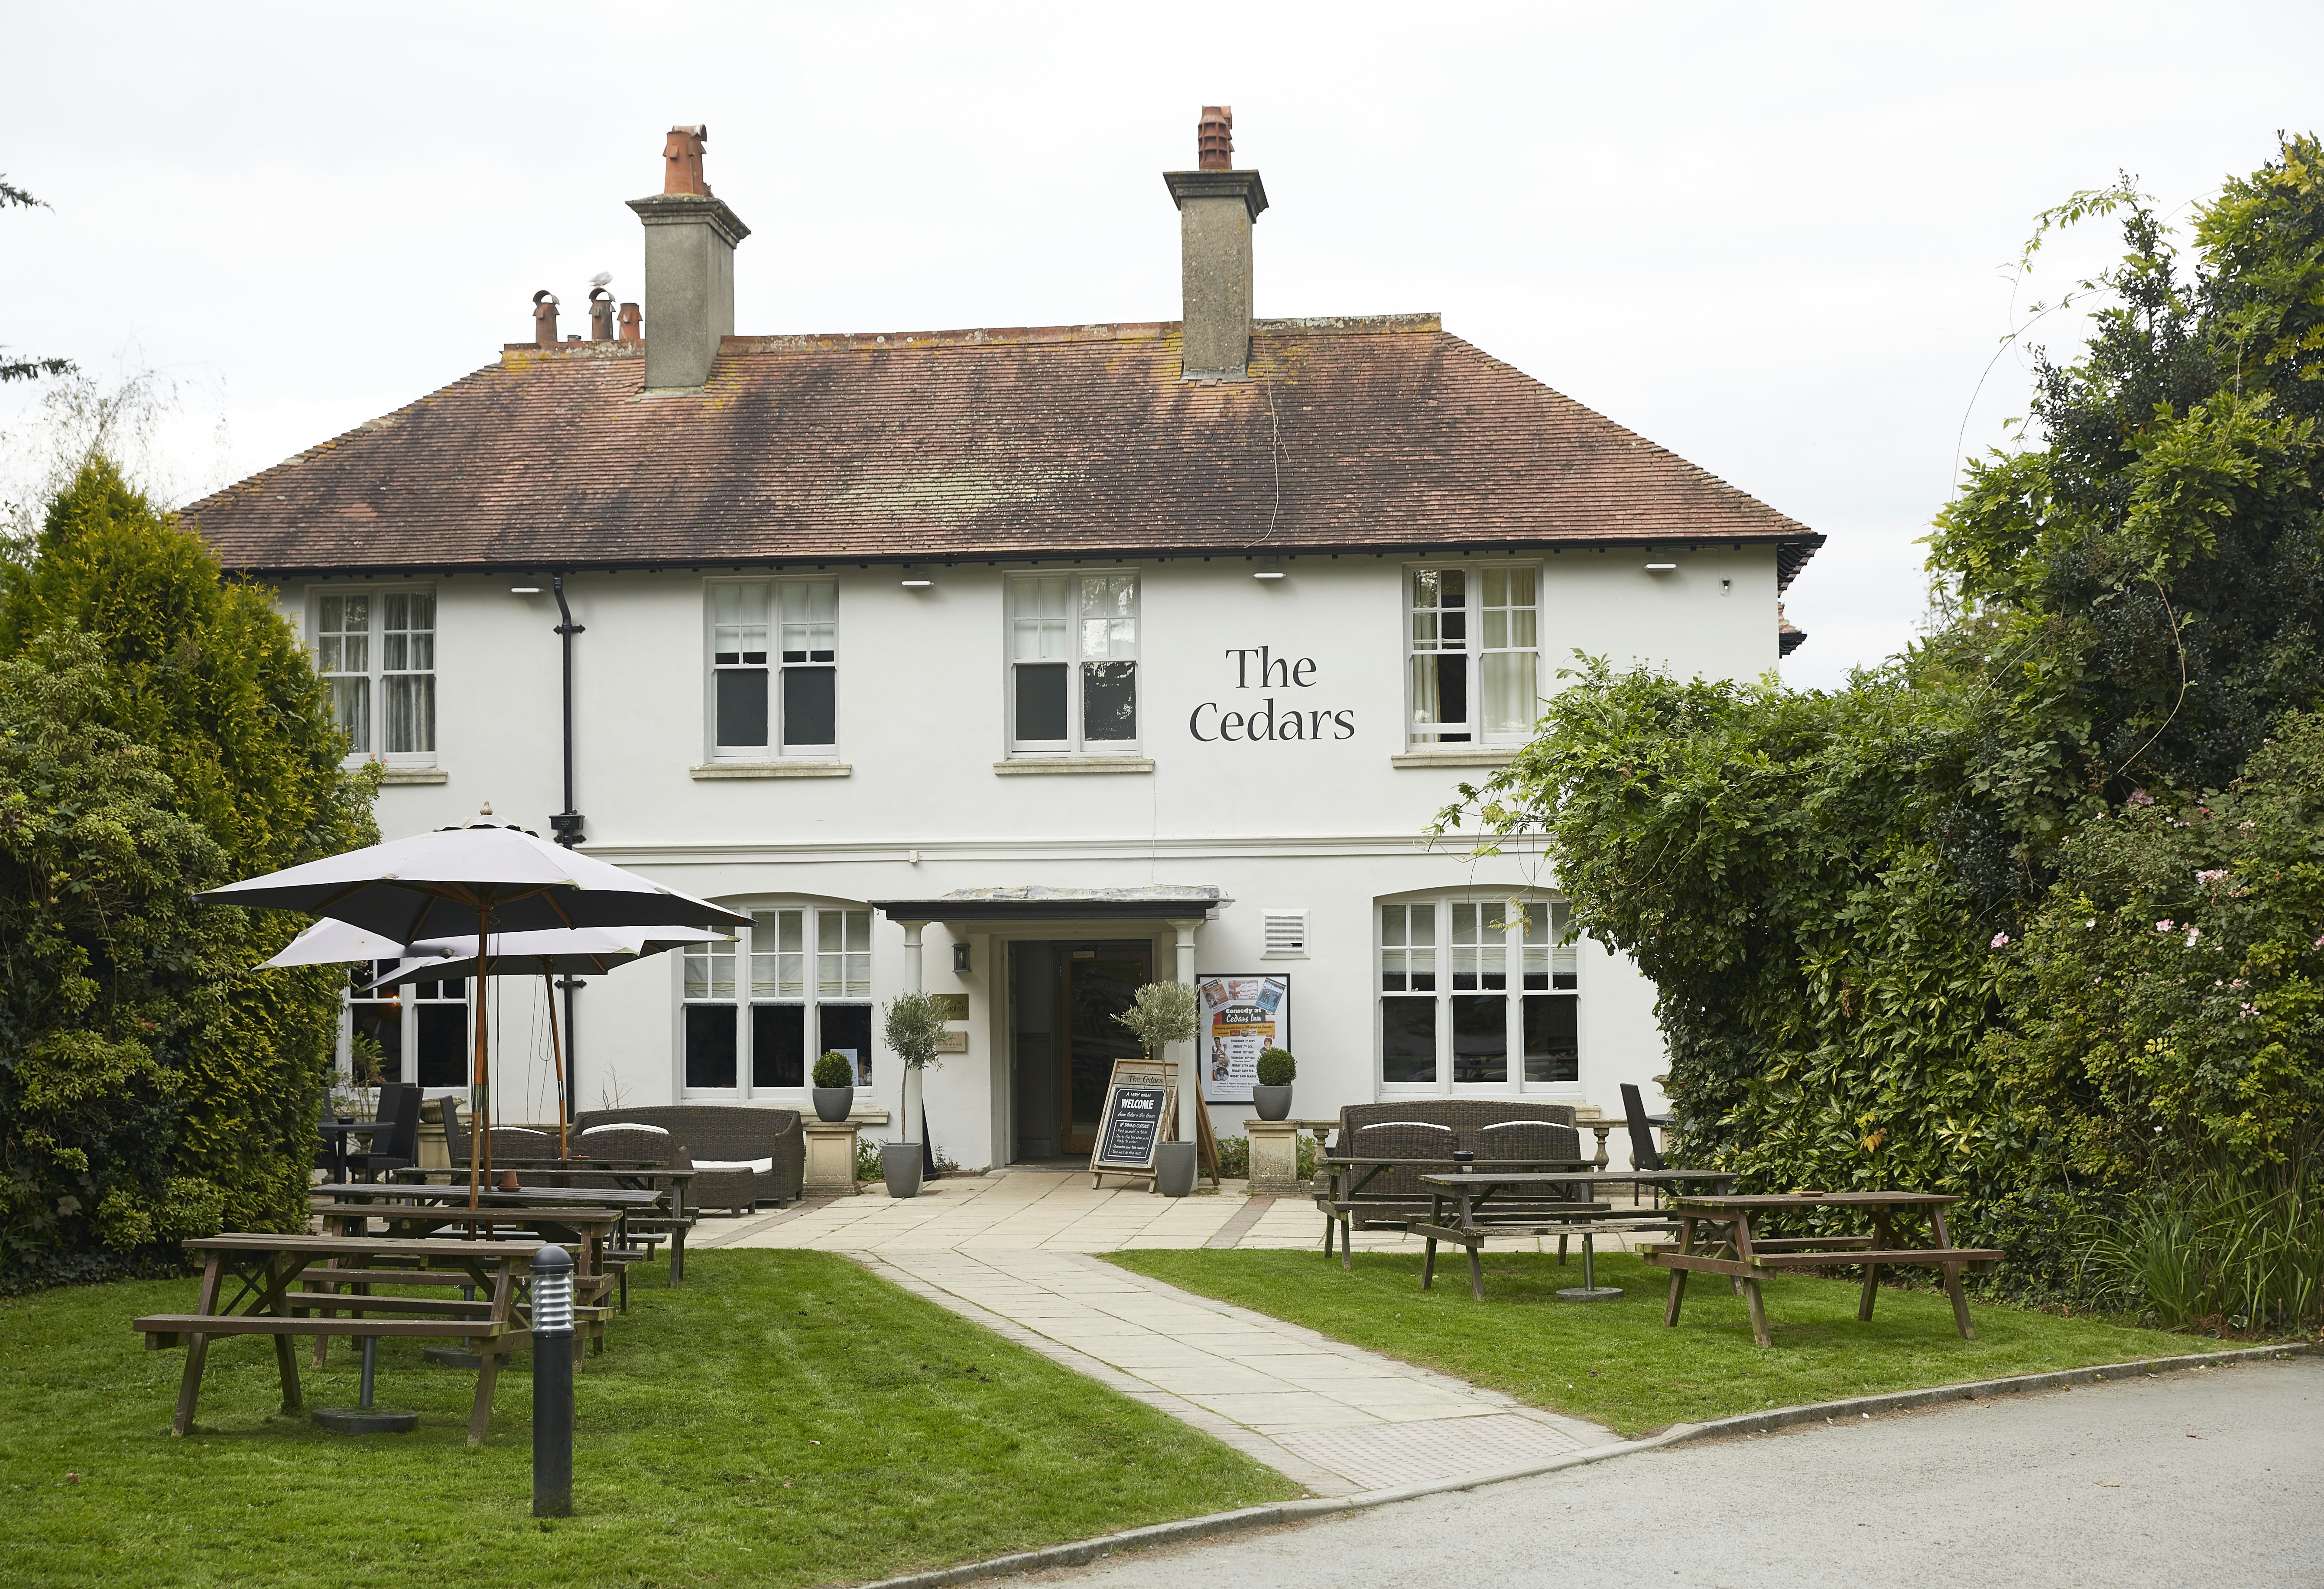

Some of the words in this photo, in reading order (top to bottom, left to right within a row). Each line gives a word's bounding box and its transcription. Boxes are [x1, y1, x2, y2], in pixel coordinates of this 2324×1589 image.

[1226, 645, 1316, 688] The
[1190, 698, 1354, 742] Cedars
[945, 1004, 966, 1013] Englsh
[1226, 1014, 1248, 1022] Cedars
[1250, 1013, 1262, 1022] Inn
[1121, 1099, 1154, 1109] WELCOME
